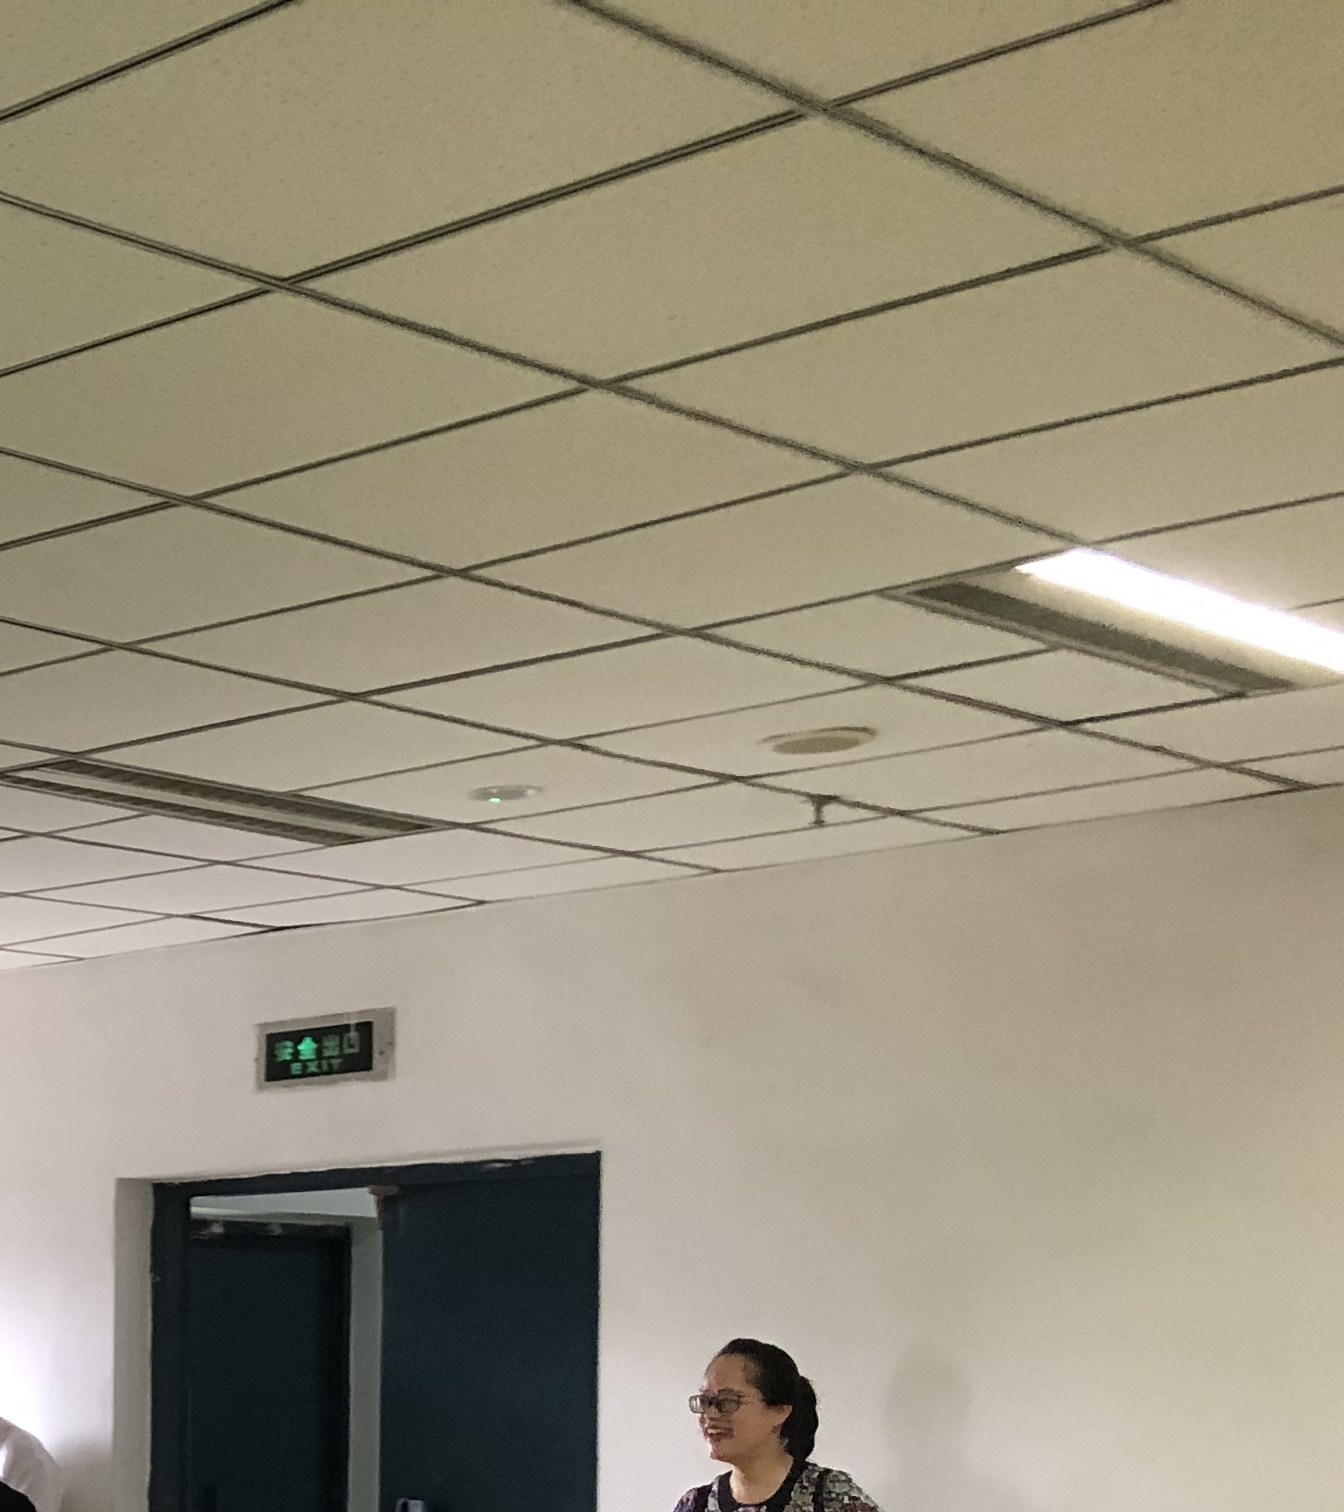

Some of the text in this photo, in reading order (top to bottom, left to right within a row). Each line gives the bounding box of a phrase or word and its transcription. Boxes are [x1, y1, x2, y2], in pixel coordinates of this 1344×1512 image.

[274, 1032, 359, 1061] 安全出口
[289, 1058, 342, 1075] EXIT
